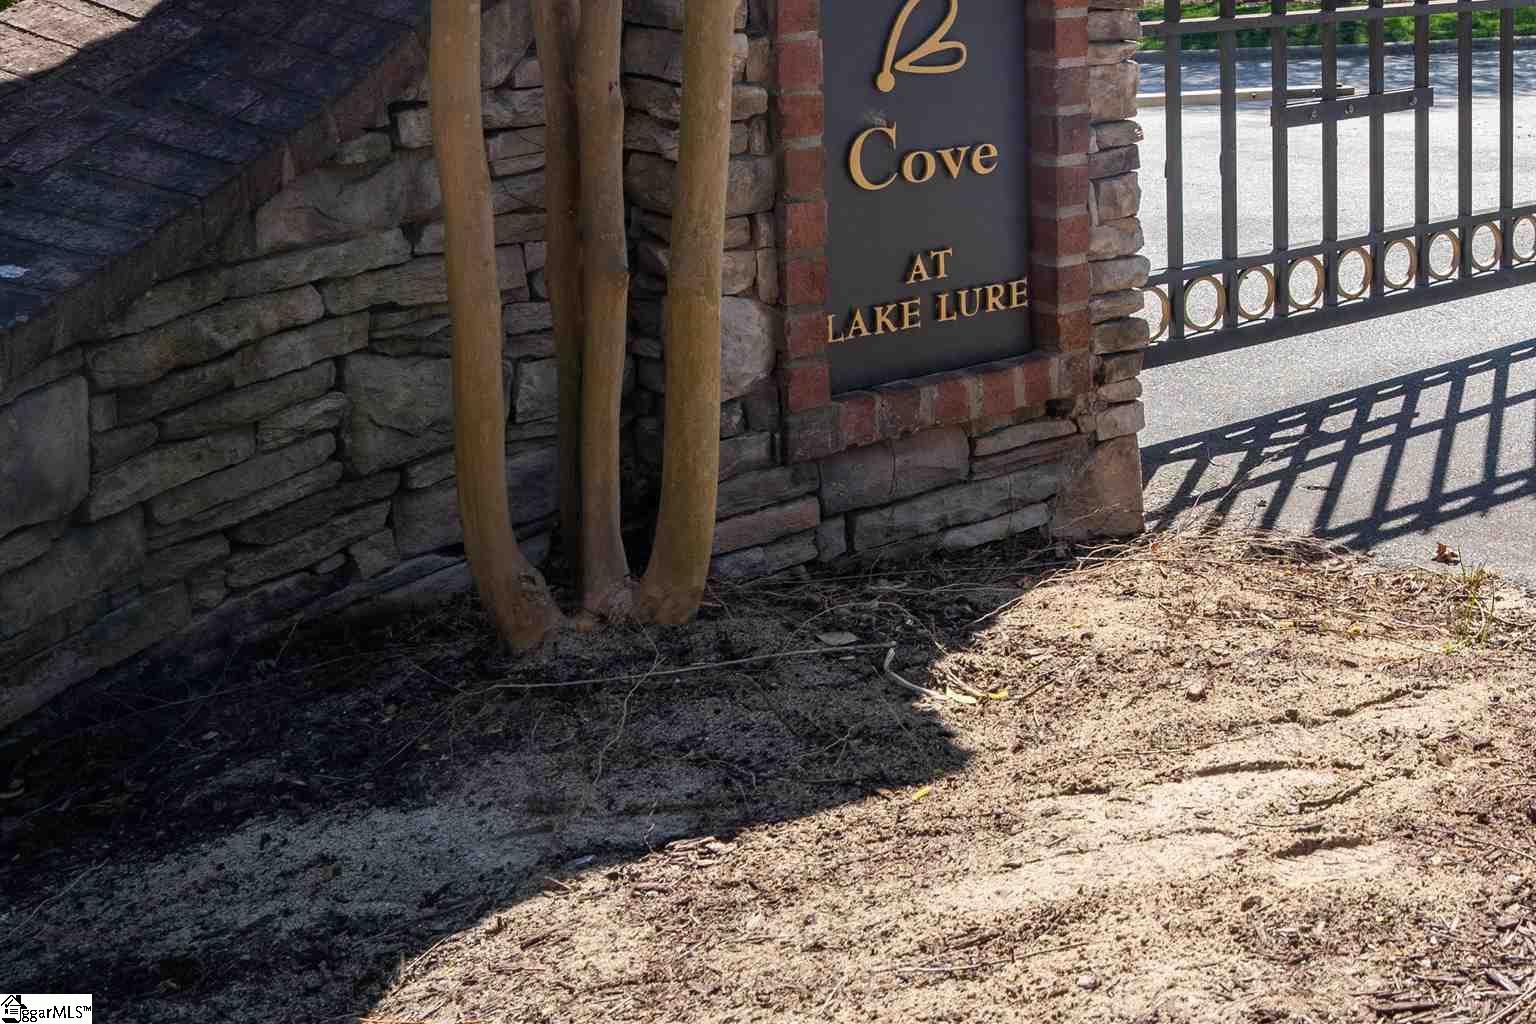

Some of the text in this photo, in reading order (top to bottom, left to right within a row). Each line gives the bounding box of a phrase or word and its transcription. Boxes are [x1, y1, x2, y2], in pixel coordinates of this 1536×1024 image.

[848, 122, 1000, 191] Cove
[906, 247, 953, 284] AT
[826, 278, 1028, 344] LAKE LURE
